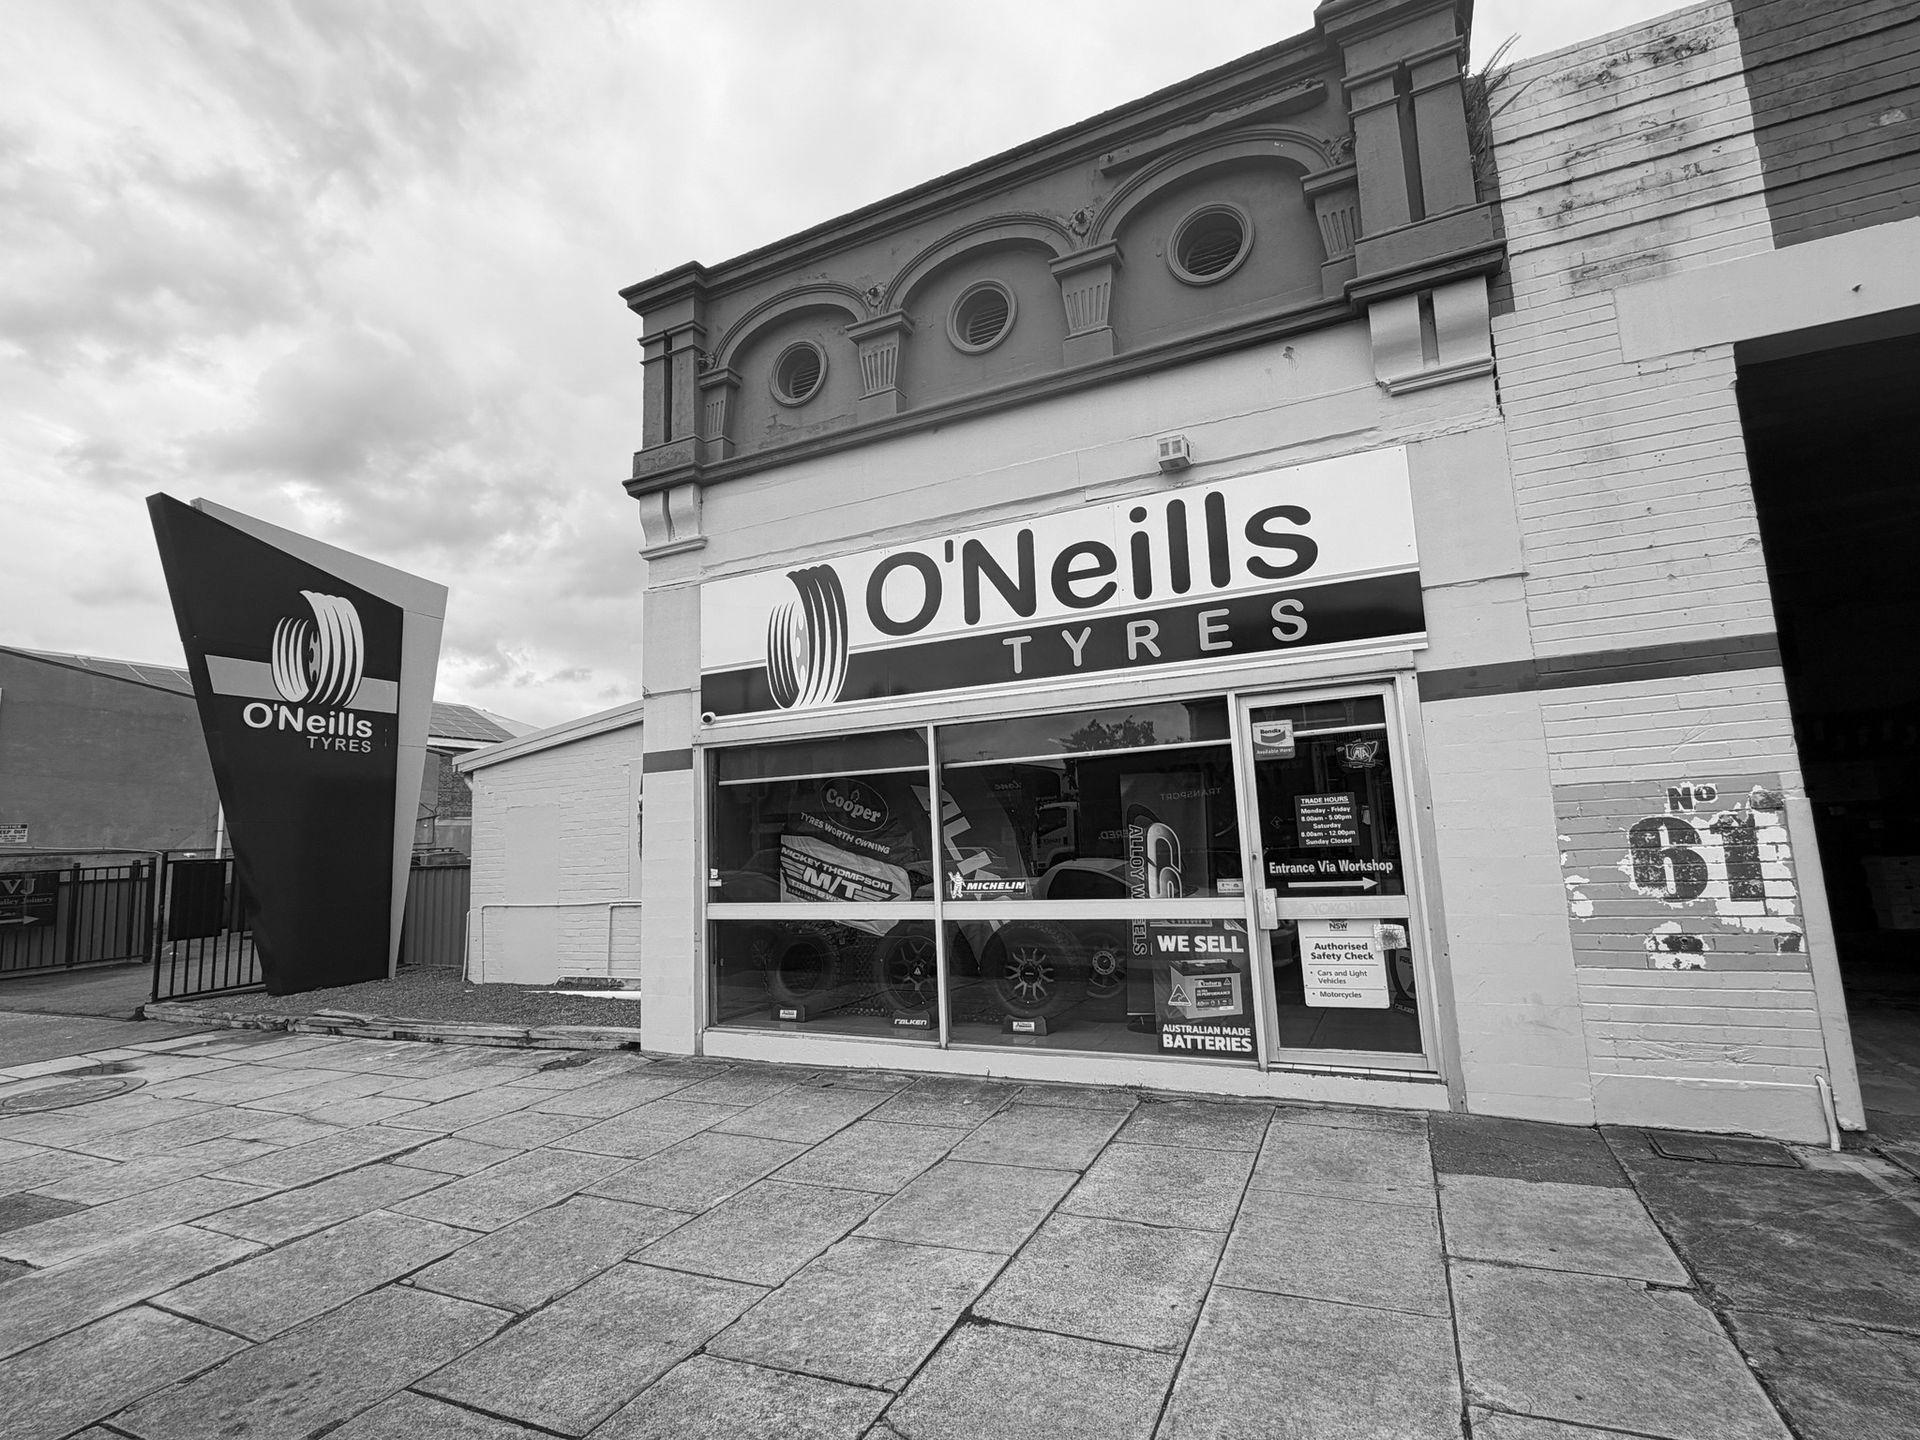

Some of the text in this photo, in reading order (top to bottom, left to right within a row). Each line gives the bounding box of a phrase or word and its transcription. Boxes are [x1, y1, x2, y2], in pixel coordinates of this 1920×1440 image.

[866, 491, 1319, 637] O'Neills
[1002, 599, 1309, 675] TYRES
[242, 702, 373, 738] O'Neills
[306, 735, 372, 753] TYRES
[826, 788, 882, 822] Cooper
[801, 812, 890, 854] TYRES WORTH OWNING
[1129, 824, 1145, 881] ALLOY
[1628, 812, 1766, 903] 61
[781, 847, 891, 891] MICKEY THOMPSON
[1269, 858, 1394, 874] Entrance Via Workshop
[802, 866, 863, 899] M/T
[966, 881, 1025, 890] MICHELIN
[1157, 935, 1244, 953] WE SELL
[1314, 942, 1368, 950] Authorised
[1311, 951, 1375, 961] Safety Check
[1318, 977, 1347, 985] Vehicles
[1349, 970, 1368, 978] Light
[1319, 991, 1362, 999] Motorcycles
[1162, 1024, 1252, 1037] AUSTRALIAN MADE
[1162, 1033, 1253, 1052] BATTERIES
